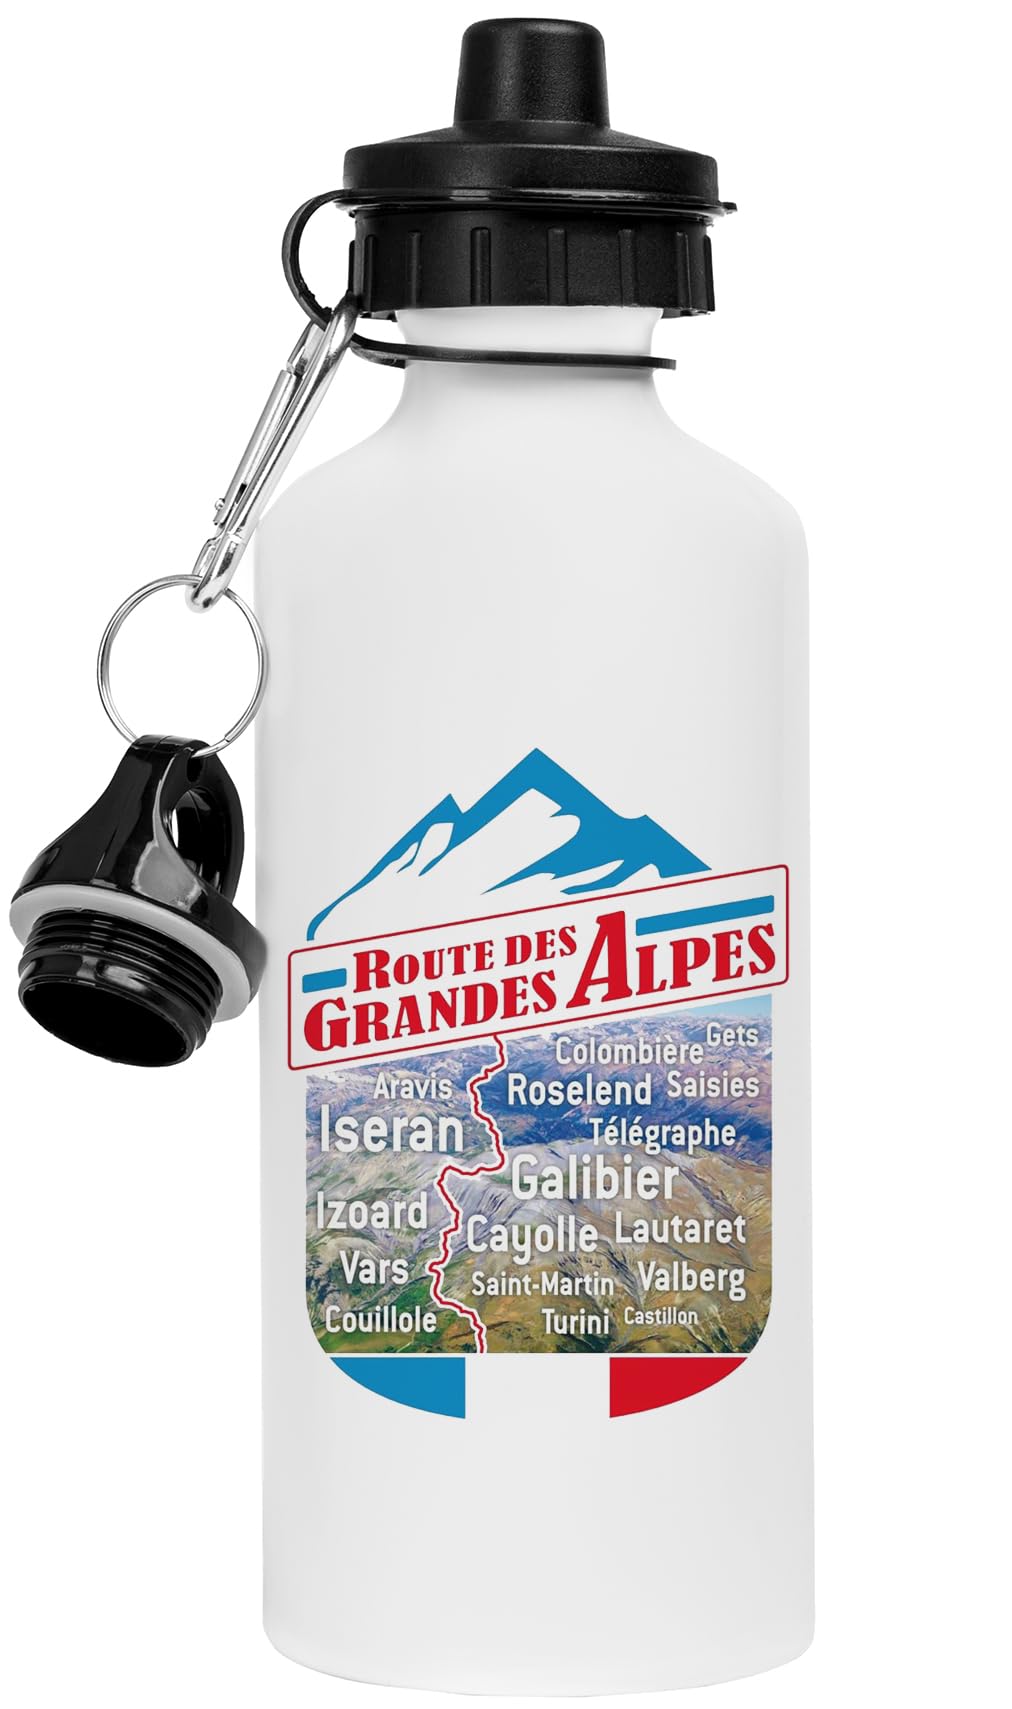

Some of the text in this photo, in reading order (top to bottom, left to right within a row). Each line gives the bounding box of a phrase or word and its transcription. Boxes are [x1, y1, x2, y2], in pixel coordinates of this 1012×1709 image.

[353, 925, 577, 992] ROUTE DES
[303, 910, 776, 1051] GRANDES ALPES
[555, 1035, 704, 1065] Colombière
[706, 1022, 759, 1047] Gets
[373, 1072, 453, 1099] Aravis
[508, 1073, 652, 1105] Roselend
[667, 1070, 760, 1098] Saisies
[321, 1104, 464, 1152] Iseran
[589, 1116, 736, 1155] Télégraphe
[511, 1154, 680, 1200] Galibier
[317, 1191, 428, 1229] Izoard
[467, 1214, 598, 1266] Cayolle
[615, 1211, 746, 1244] Lautaret
[340, 1250, 409, 1284] Vars
[471, 1271, 614, 1296] Saint-Martin
[637, 1261, 746, 1302] Valberg
[325, 1305, 437, 1333] Couillole
[541, 1308, 610, 1334] Turini
[624, 1306, 699, 1326] Castillon
